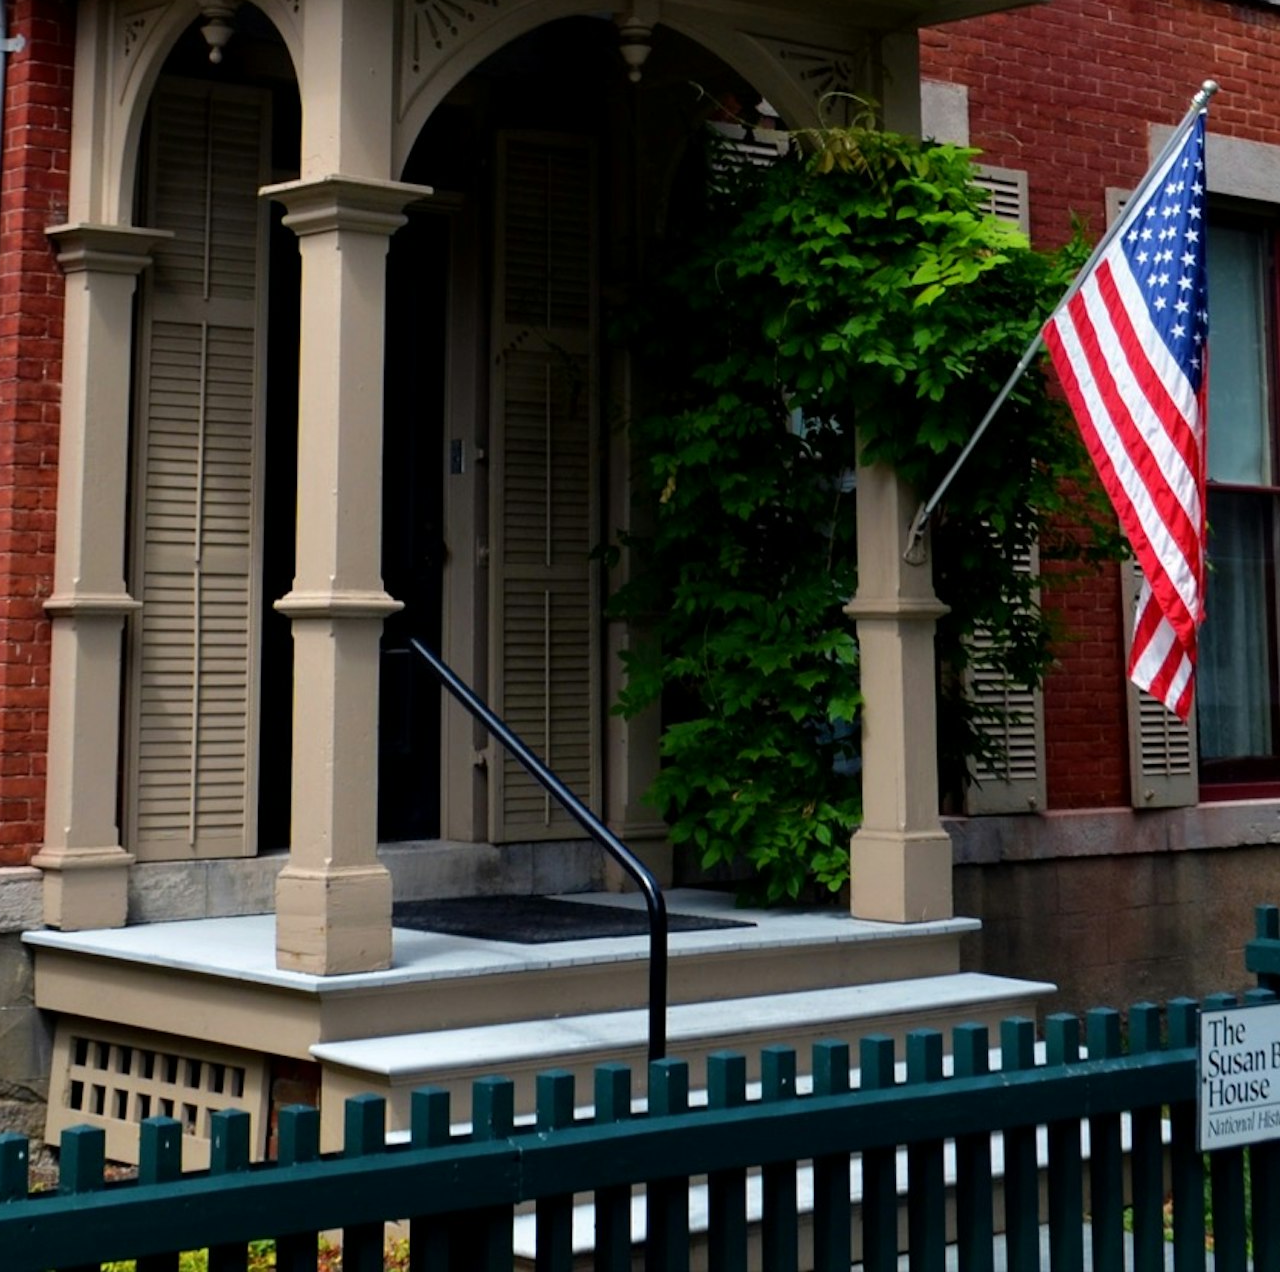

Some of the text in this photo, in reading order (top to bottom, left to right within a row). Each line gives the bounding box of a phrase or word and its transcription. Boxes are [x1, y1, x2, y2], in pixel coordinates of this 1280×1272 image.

[1208, 1016, 1246, 1048] The
[1208, 1049, 1266, 1079] Susan
[1209, 1077, 1271, 1108] House
[1207, 1112, 1255, 1139] National
